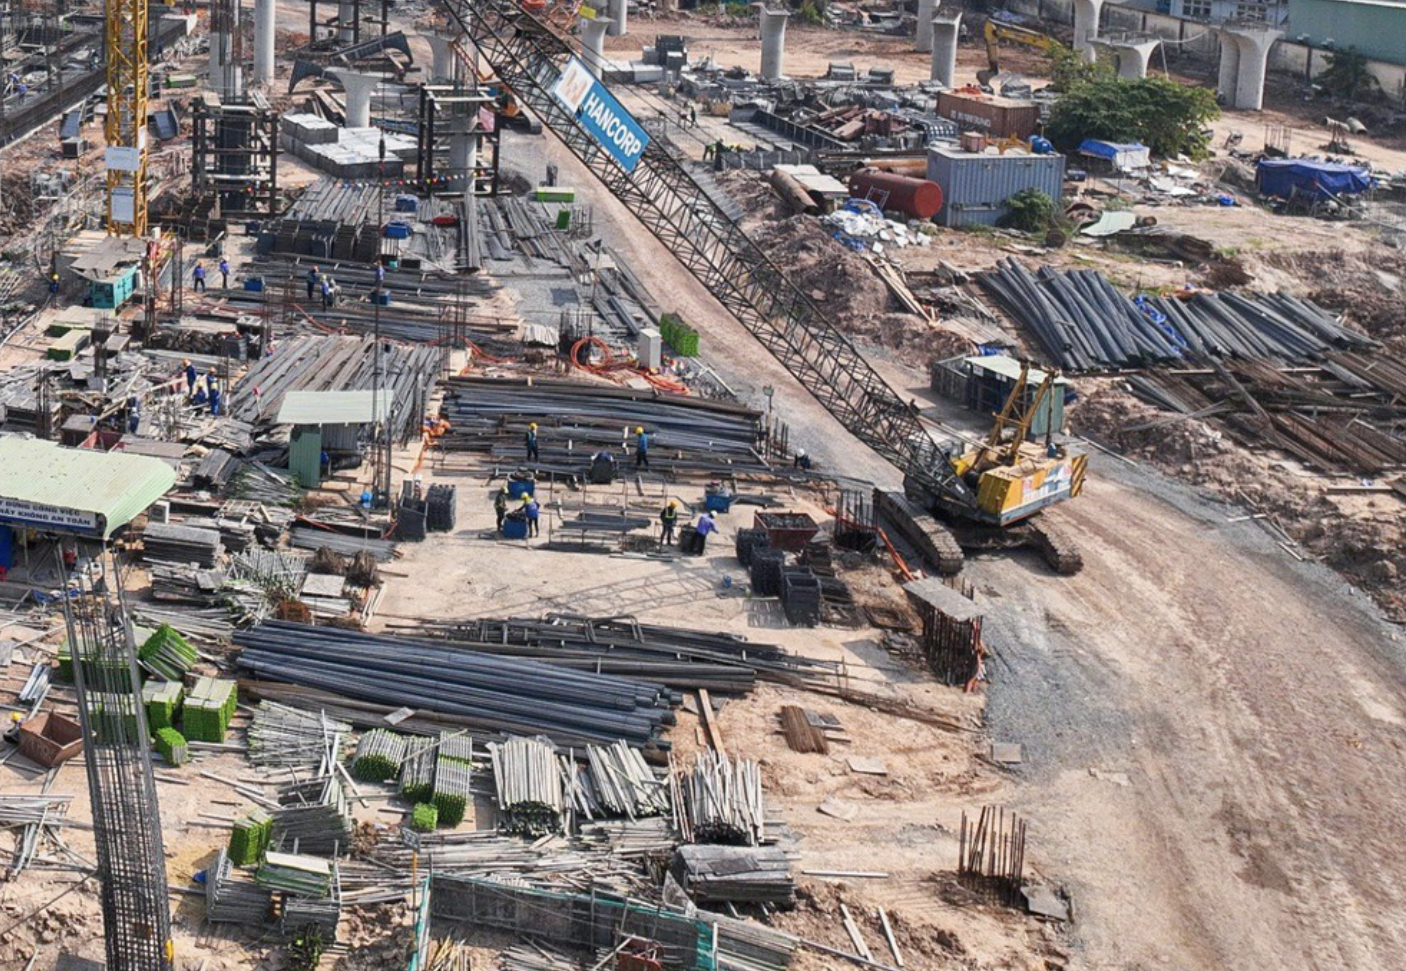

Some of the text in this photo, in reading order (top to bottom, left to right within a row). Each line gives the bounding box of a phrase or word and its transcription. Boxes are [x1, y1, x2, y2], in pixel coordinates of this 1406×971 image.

[583, 92, 642, 157] HANCORP
[18, 509, 50, 521] KHÔNG
[66, 516, 91, 526] TOÀN
[32, 503, 58, 514] CÔNG
[59, 507, 81, 517] VIỆC
